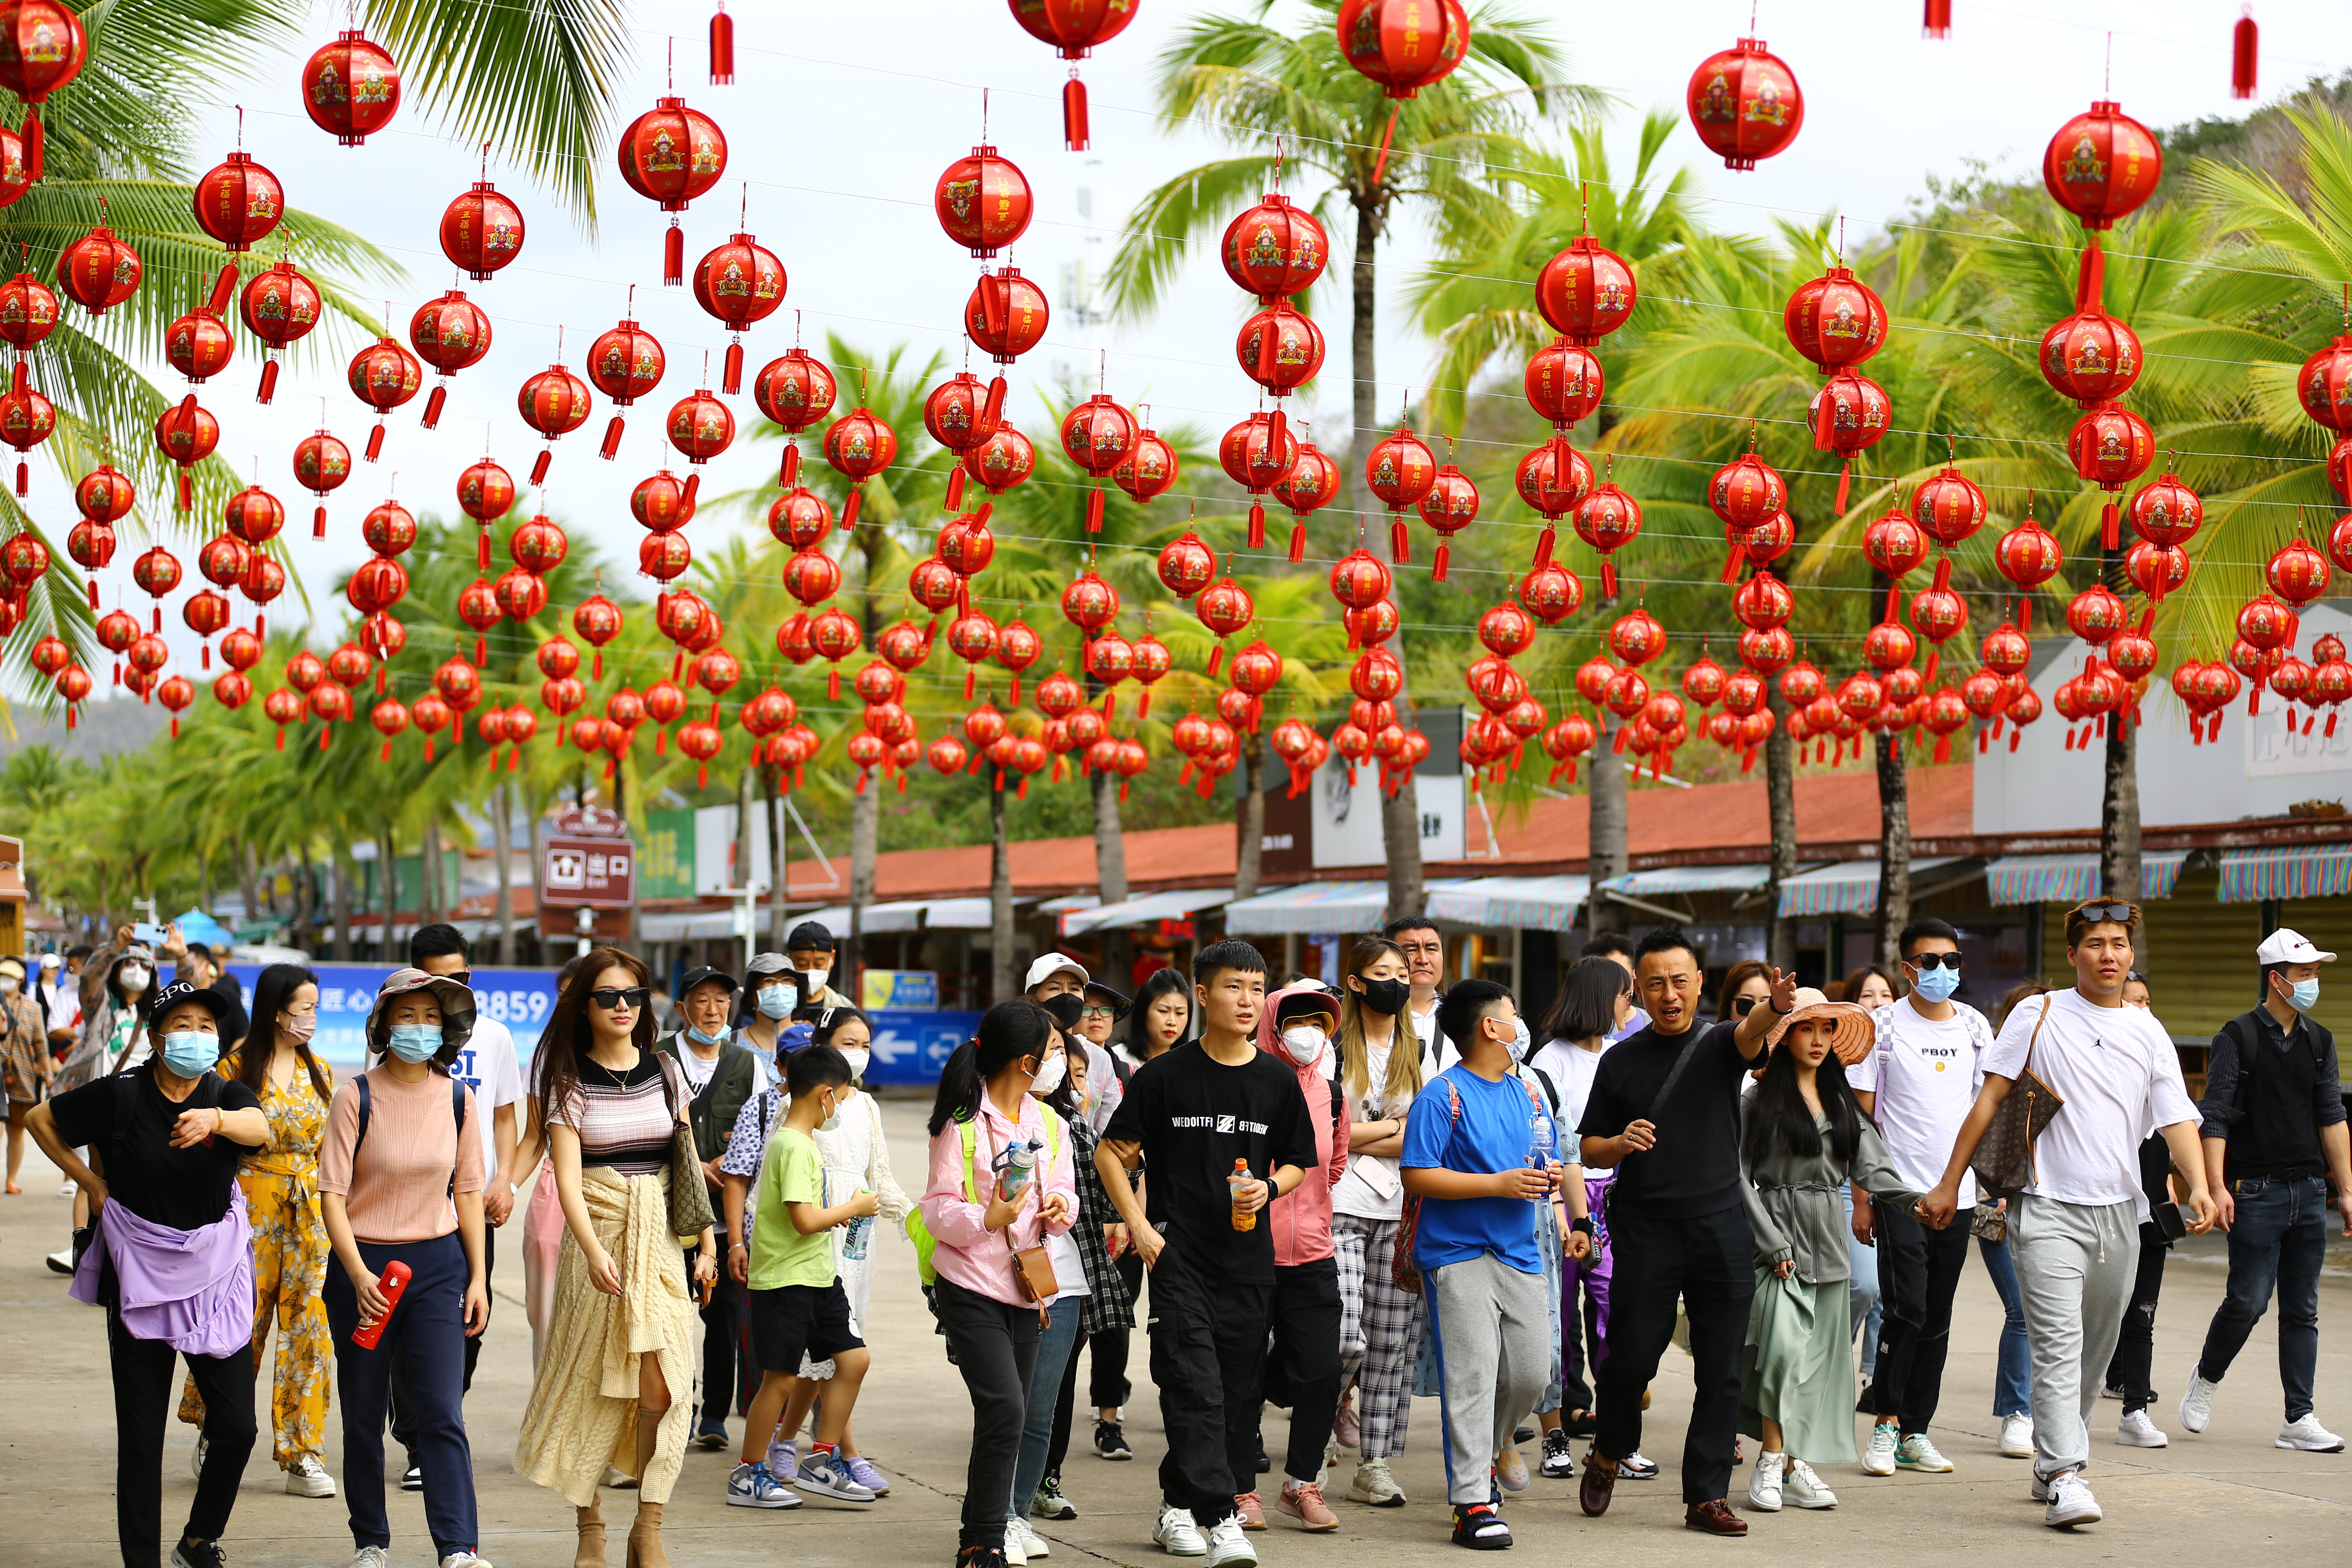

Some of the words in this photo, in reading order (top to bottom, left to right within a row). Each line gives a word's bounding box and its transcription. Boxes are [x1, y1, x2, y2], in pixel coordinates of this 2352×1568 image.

[220, 180, 231, 219] 五福临门
[997, 177, 1010, 221] 五福临门
[460, 210, 470, 249] 五福临门
[89, 250, 100, 284] 五福临门
[1566, 267, 1578, 310] 五福临门
[1020, 296, 1032, 333] 五福临门
[1801, 296, 1813, 338] 五福临门
[1541, 362, 1552, 398] 五福临门
[1232, 436, 1241, 468] 五福临门
[1410, 455, 1422, 488] 五福临门
[1741, 479, 1753, 510] 五福临门
[1949, 493, 1958, 523] 五福临门
[587, 853, 628, 877] 出口
[154, 982, 196, 1008] SPO
[448, 1050, 476, 1075] ST
